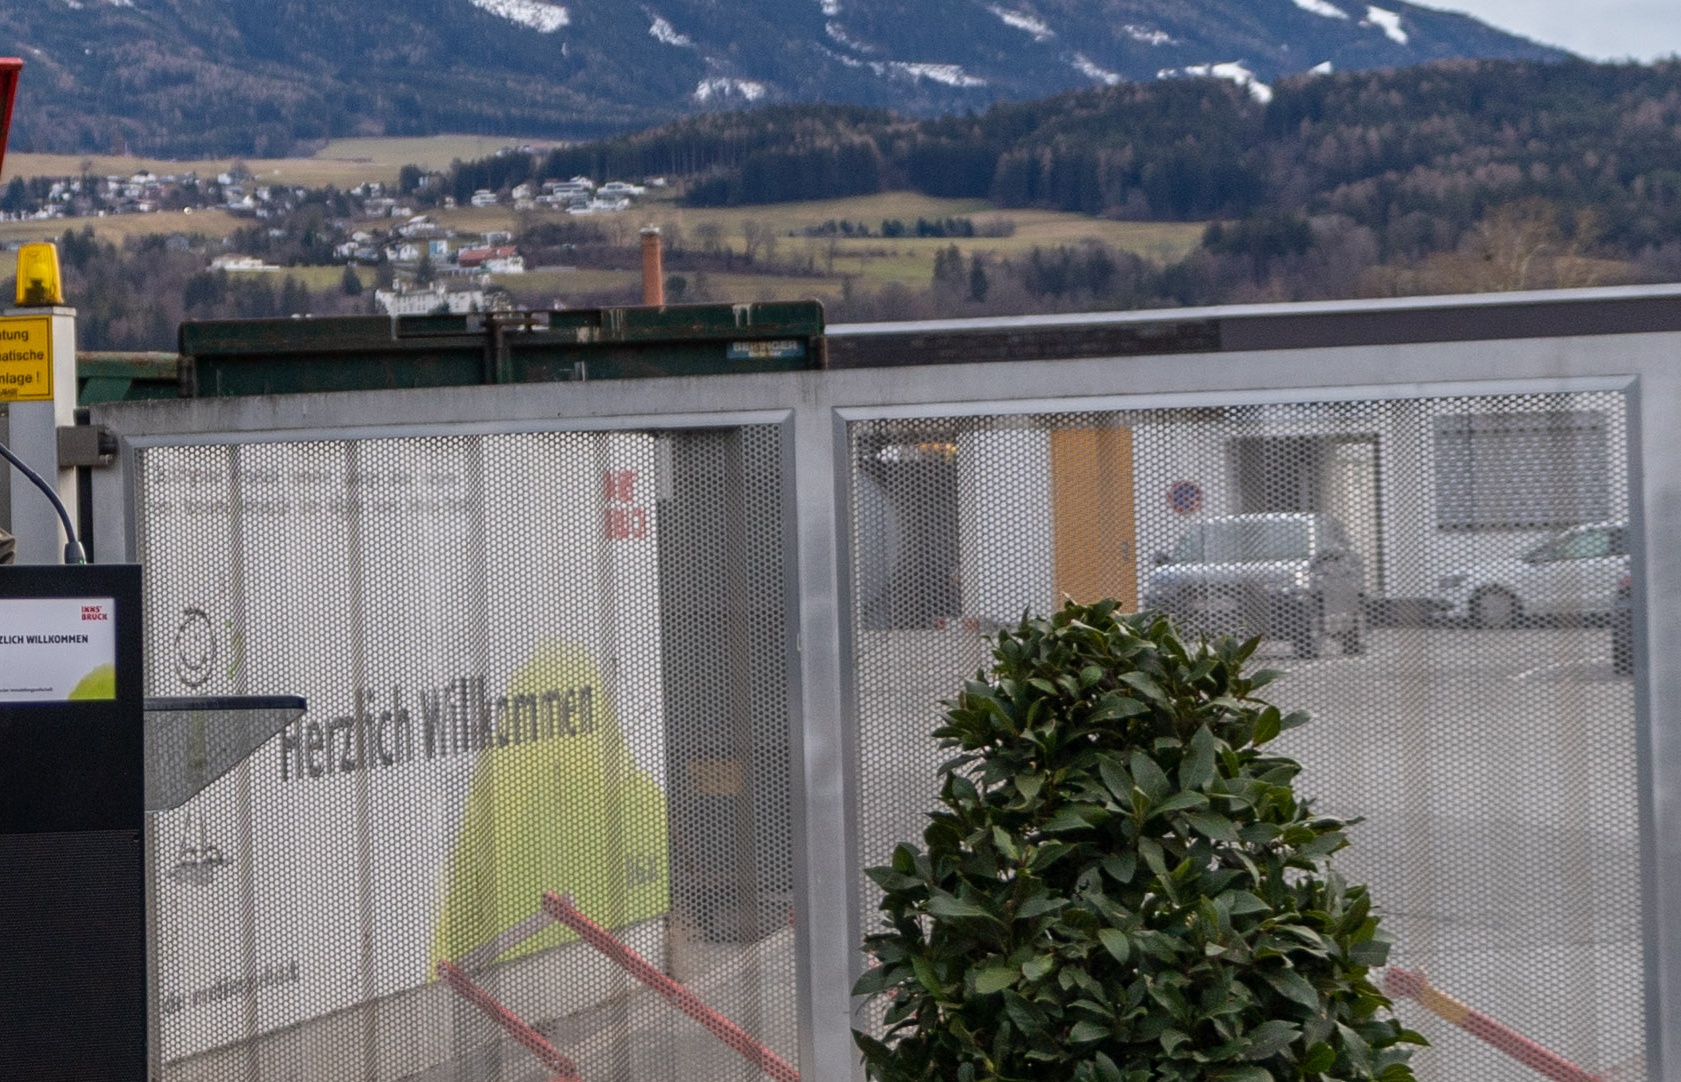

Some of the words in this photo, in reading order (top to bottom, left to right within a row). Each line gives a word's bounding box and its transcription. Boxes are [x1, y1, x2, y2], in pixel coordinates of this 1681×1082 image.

[81, 613, 108, 621] BRUCK
[26, 634, 88, 644] WILLKOMMEN
[281, 685, 410, 782] Herzlich
